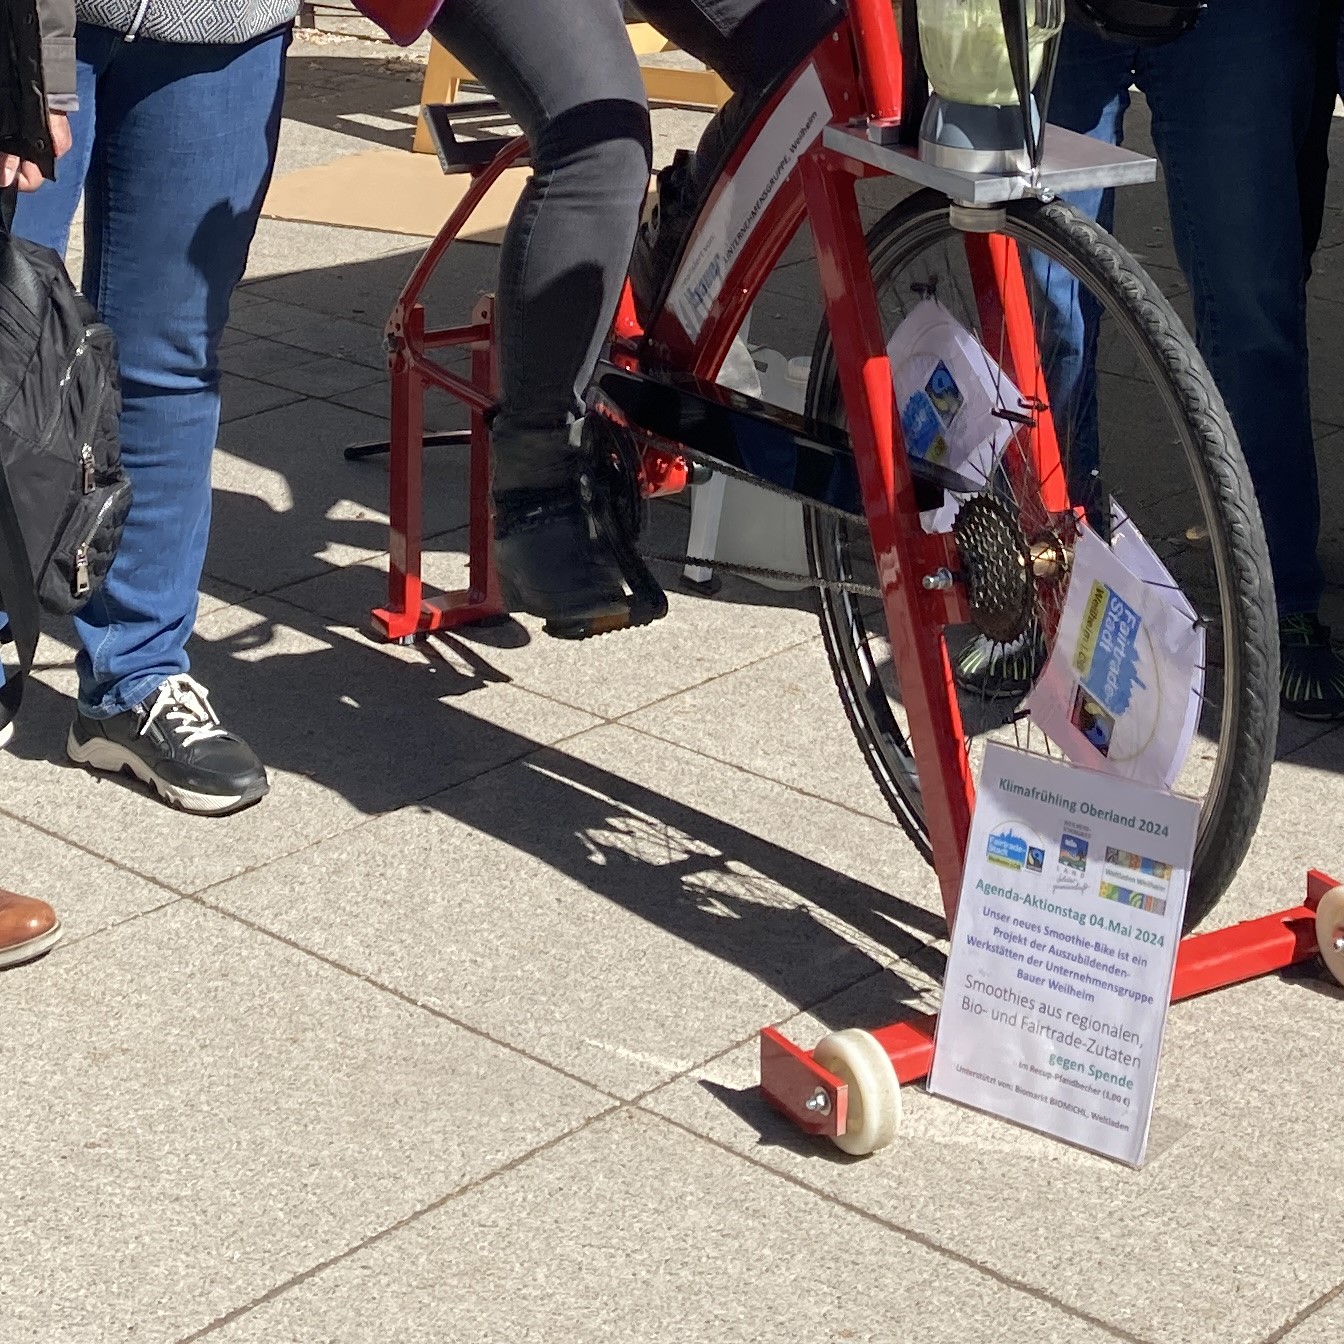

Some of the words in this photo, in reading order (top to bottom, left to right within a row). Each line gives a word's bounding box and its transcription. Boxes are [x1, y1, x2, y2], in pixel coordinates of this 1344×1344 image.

[999, 779, 1076, 812] Klimafrühling
[1080, 802, 1135, 827] Oberland
[1138, 819, 1167, 836] 2024
[976, 880, 1085, 924] Agenda-Aktionstag
[1135, 928, 1163, 946] 2024
[983, 906, 1010, 922] Unser
[1012, 918, 1040, 932] neues
[1044, 926, 1114, 955] Smoothie-Bike
[1117, 949, 1129, 961] ist
[1132, 956, 1146, 966] ein
[967, 935, 1023, 960] Werkstätten
[1026, 955, 1042, 966] der
[1046, 962, 1152, 1003] Unternehmensgruppe
[993, 926, 1026, 945] Projekt
[1030, 939, 1046, 950] der
[1048, 945, 1128, 976] Auszubildenden-
[965, 975, 1034, 1009] Smoothies
[1038, 1002, 1061, 1018] aus
[1066, 1012, 1141, 1046] regionalen,
[1017, 968, 1044, 984] Bauer
[1048, 979, 1094, 1001] Weilheim
[962, 996, 986, 1014] Bio-
[991, 1009, 1016, 1026] und
[1021, 1016, 1140, 1066] Fairtrade-Zutaten
[1049, 1054, 1084, 1072] gegen
[1088, 1064, 1132, 1088] Spende
